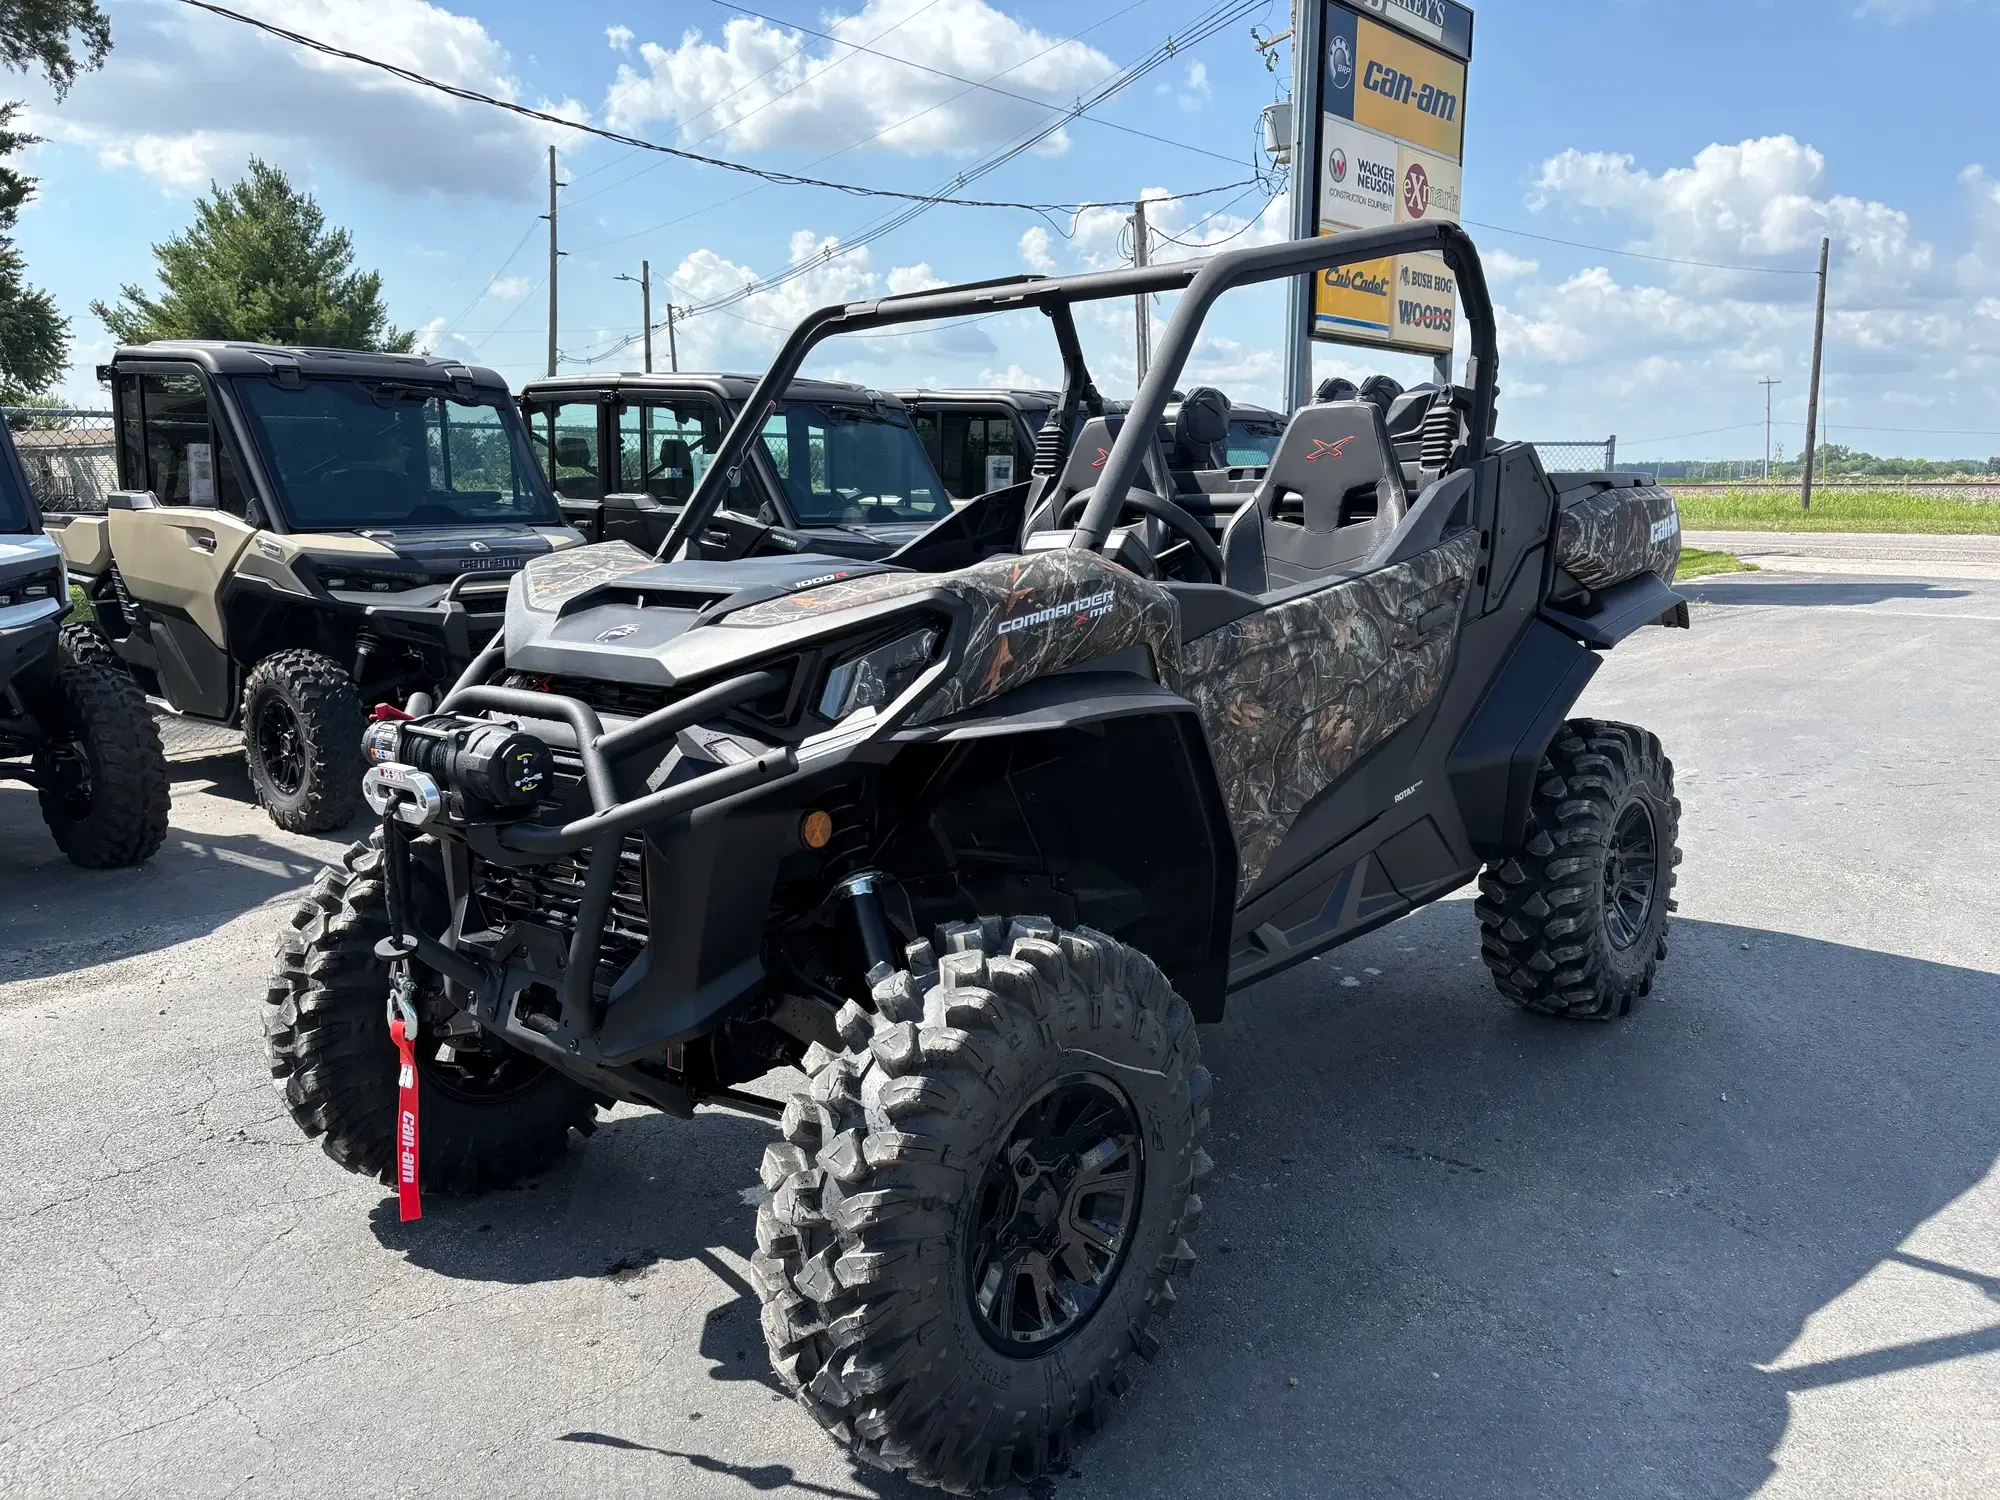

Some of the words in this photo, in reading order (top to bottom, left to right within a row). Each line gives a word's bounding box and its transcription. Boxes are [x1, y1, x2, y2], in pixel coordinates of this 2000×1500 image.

[1337, 63, 1351, 75] BRP
[1363, 60, 1457, 122] can-am
[1357, 157, 1396, 183] WACKER
[1357, 173, 1395, 197] NEUSON
[1328, 187, 1367, 206] CONSTRUCTION
[1367, 198, 1393, 213] EQUIPMENT
[1325, 266, 1351, 288] Cub
[1351, 271, 1389, 296] Cadet
[1411, 270, 1433, 289] BUSH
[1434, 275, 1453, 293] HOG
[1398, 299, 1452, 332] WOODS
[461, 556, 521, 569] can-am
[998, 590, 1115, 635] COMMANDER
[1394, 785, 1416, 803] ROTAX
[401, 1110, 415, 1184] can-am
